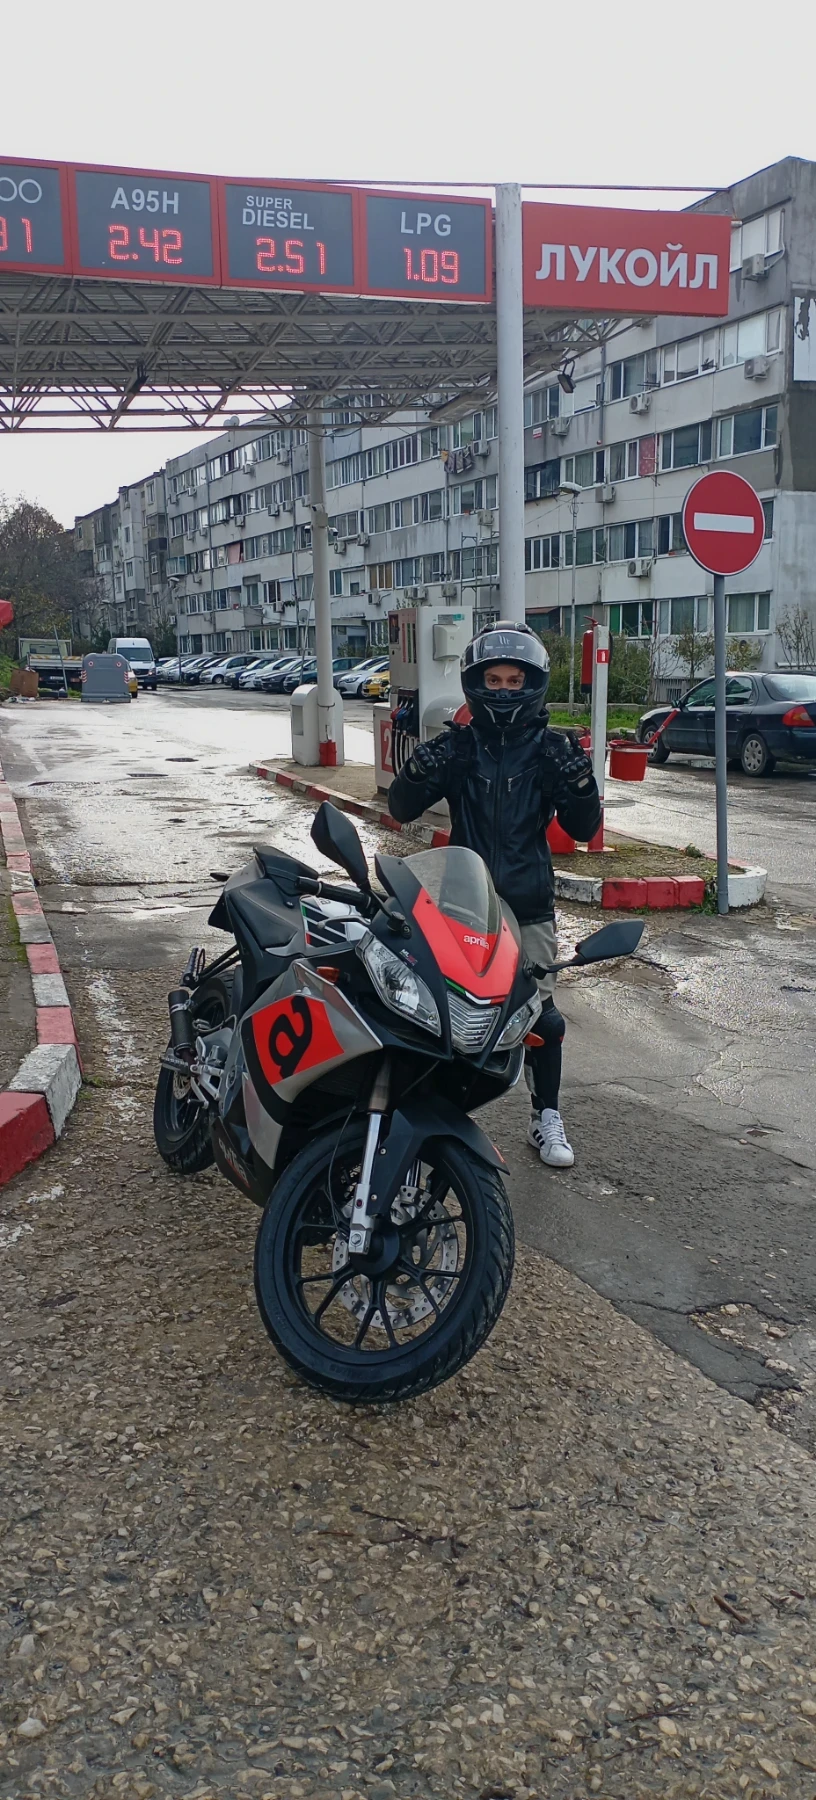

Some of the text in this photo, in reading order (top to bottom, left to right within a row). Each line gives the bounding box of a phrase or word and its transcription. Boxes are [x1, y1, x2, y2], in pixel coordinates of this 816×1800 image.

[242, 208, 315, 230] DIESEL
[246, 195, 292, 210] SUPER
[401, 212, 451, 236] LPG
[109, 225, 183, 264] 2.42
[256, 238, 326, 275] 2.51
[403, 248, 459, 284] 1.09
[535, 242, 719, 290] ЛУКОЙЛ
[383, 728, 393, 768] 2
[463, 935, 490, 950] aprilia
